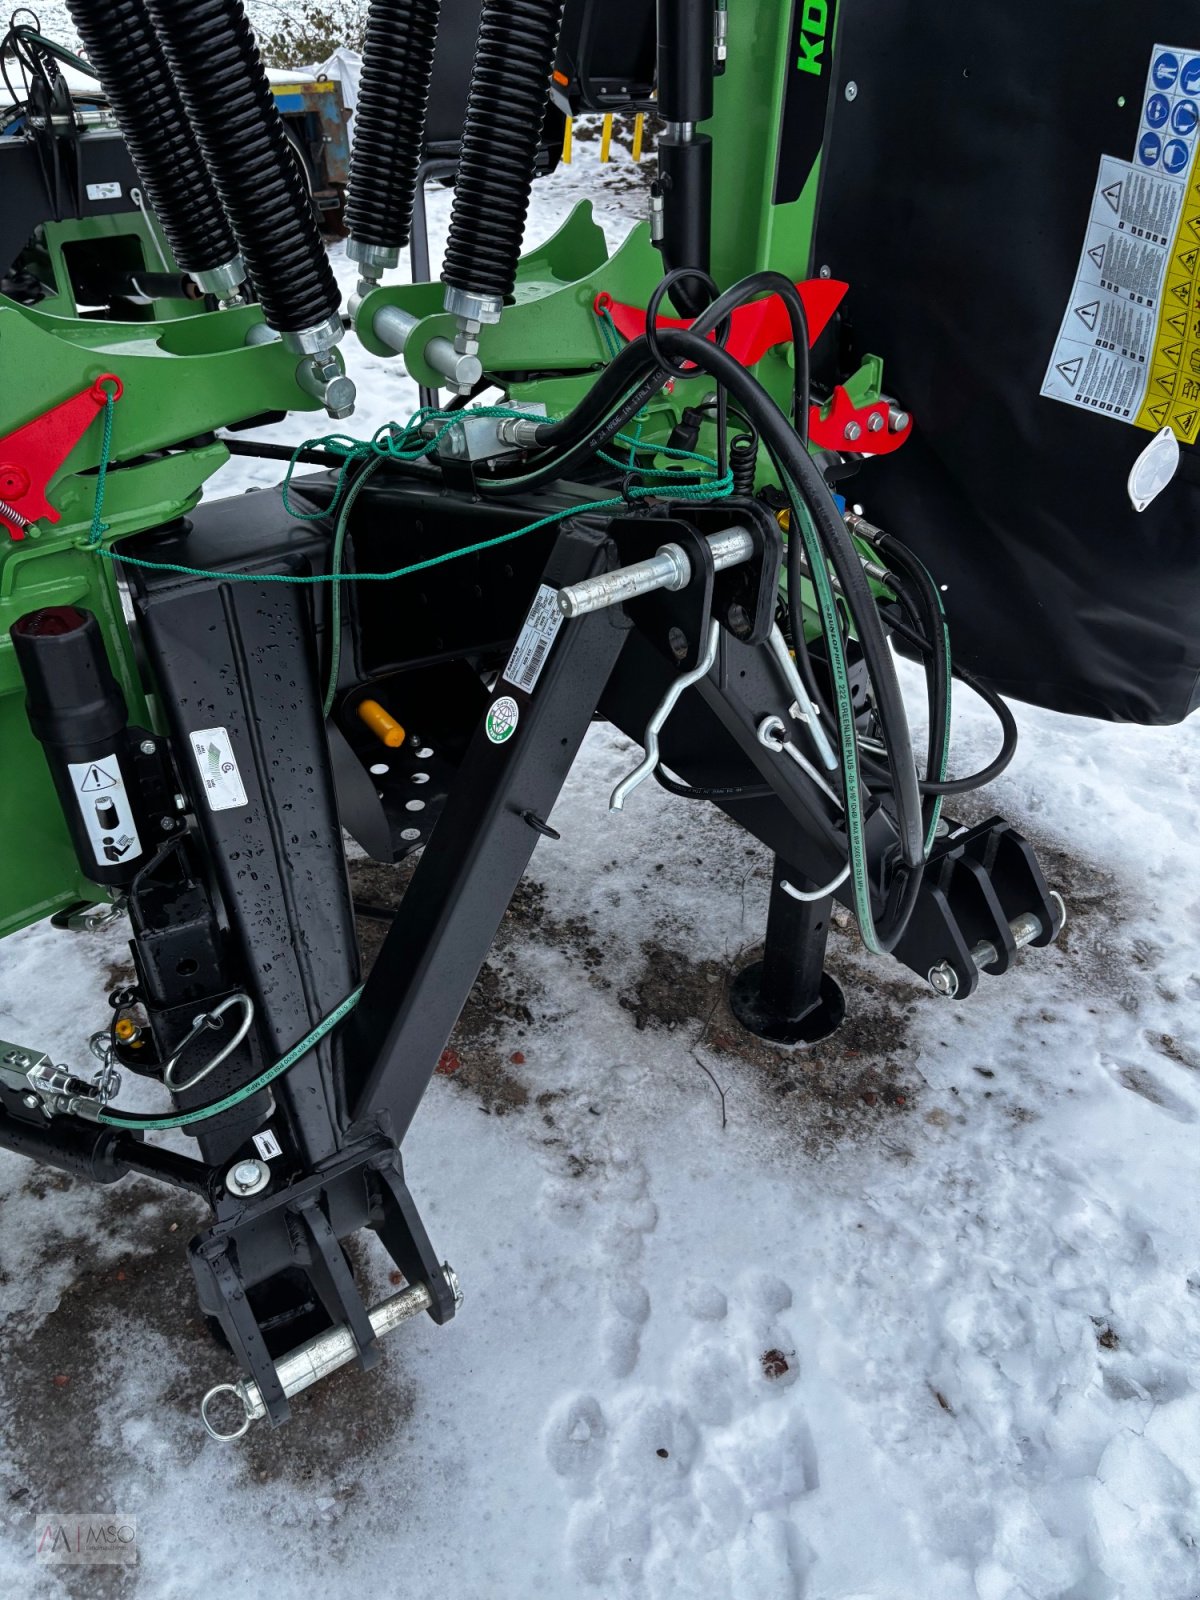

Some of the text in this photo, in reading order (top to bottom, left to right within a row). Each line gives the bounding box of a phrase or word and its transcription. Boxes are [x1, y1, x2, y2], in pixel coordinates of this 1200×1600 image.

[826, 611, 839, 652] DUNLOP
[834, 652, 843, 680] HIFLEX
[838, 683, 846, 699] 222
[840, 701, 852, 748] GREENLINE
[845, 749, 854, 770] PLUS
[851, 820, 859, 834] MAX
[306, 1030, 321, 1045] MAX
